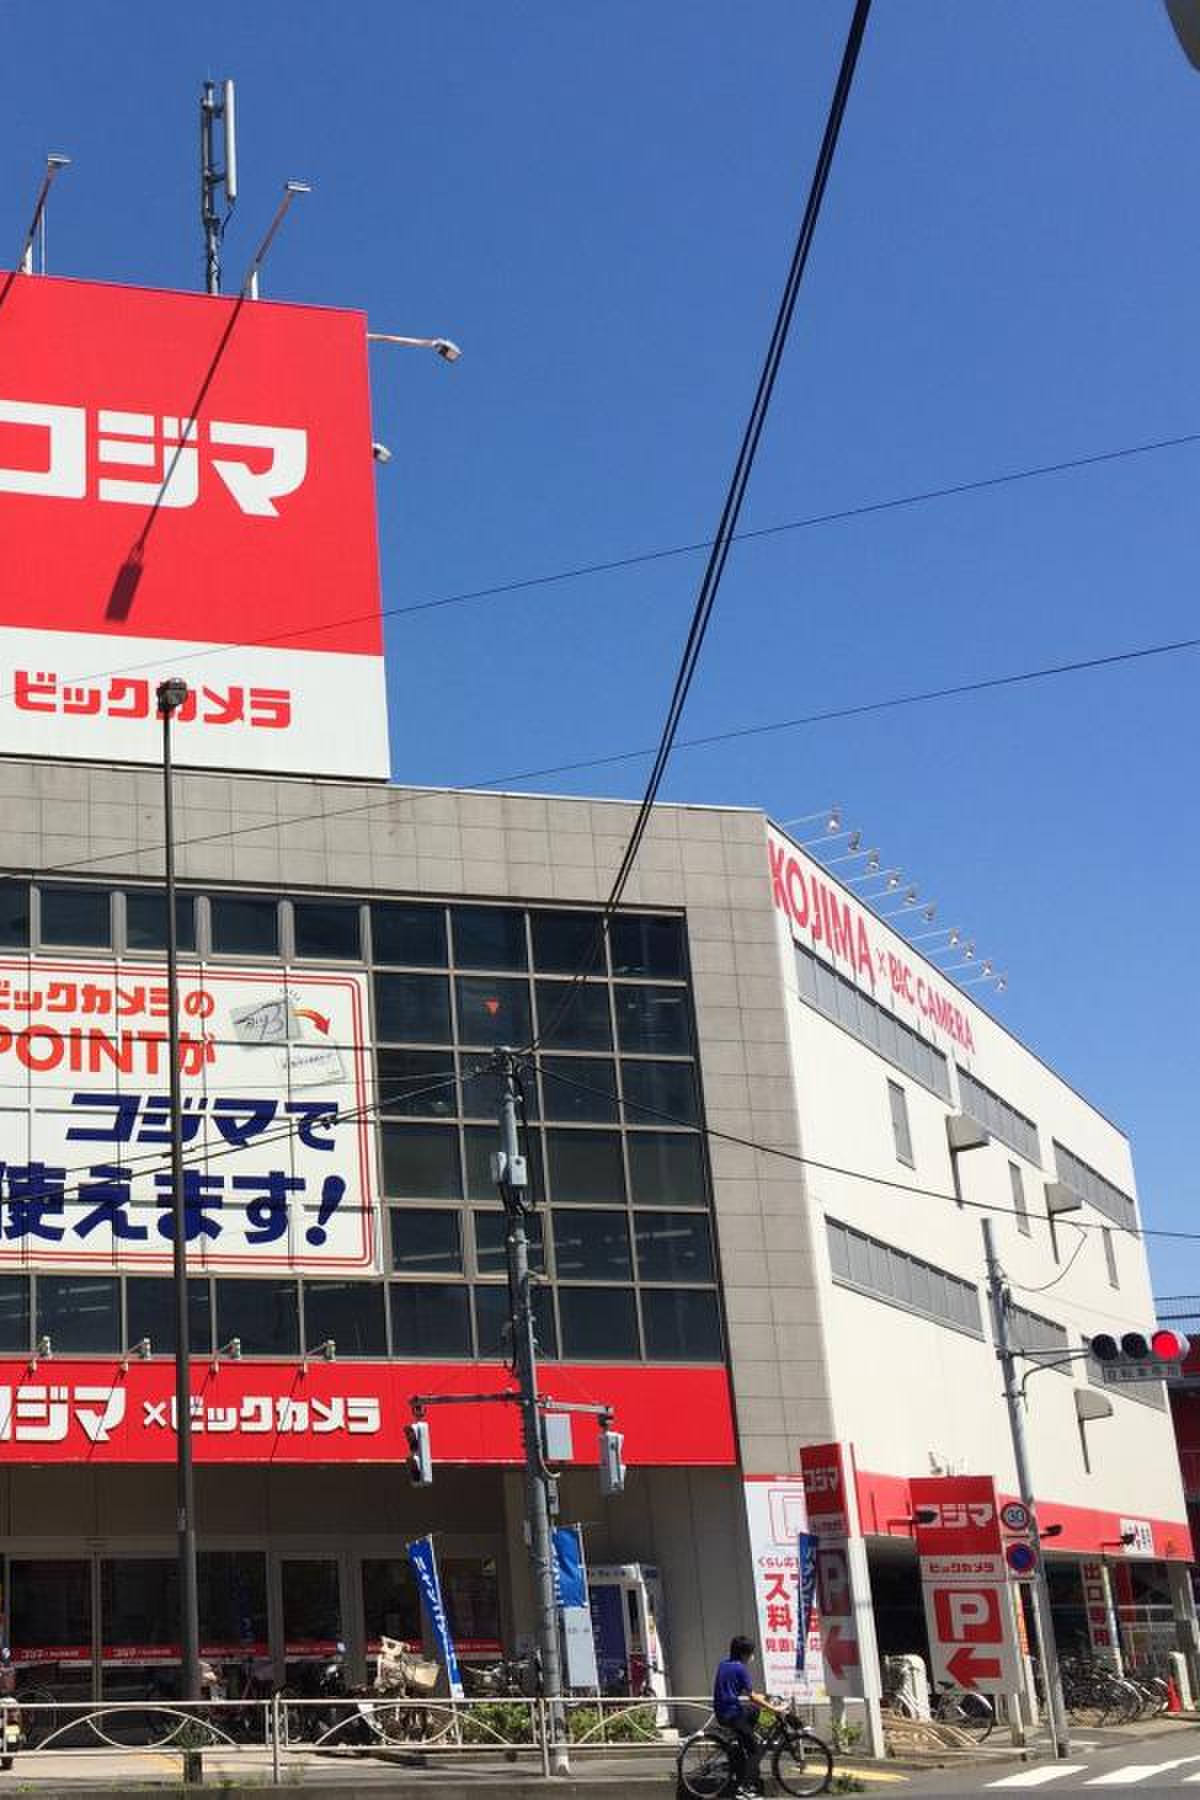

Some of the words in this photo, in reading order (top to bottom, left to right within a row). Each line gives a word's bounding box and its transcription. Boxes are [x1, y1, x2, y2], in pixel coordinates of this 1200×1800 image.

[767, 838, 876, 990] KOJIMA
[917, 976, 977, 1055] CAMERA
[65, 1093, 339, 1152] コジマで
[915, 1503, 993, 1528] コジマ
[949, 1592, 990, 1640] P
